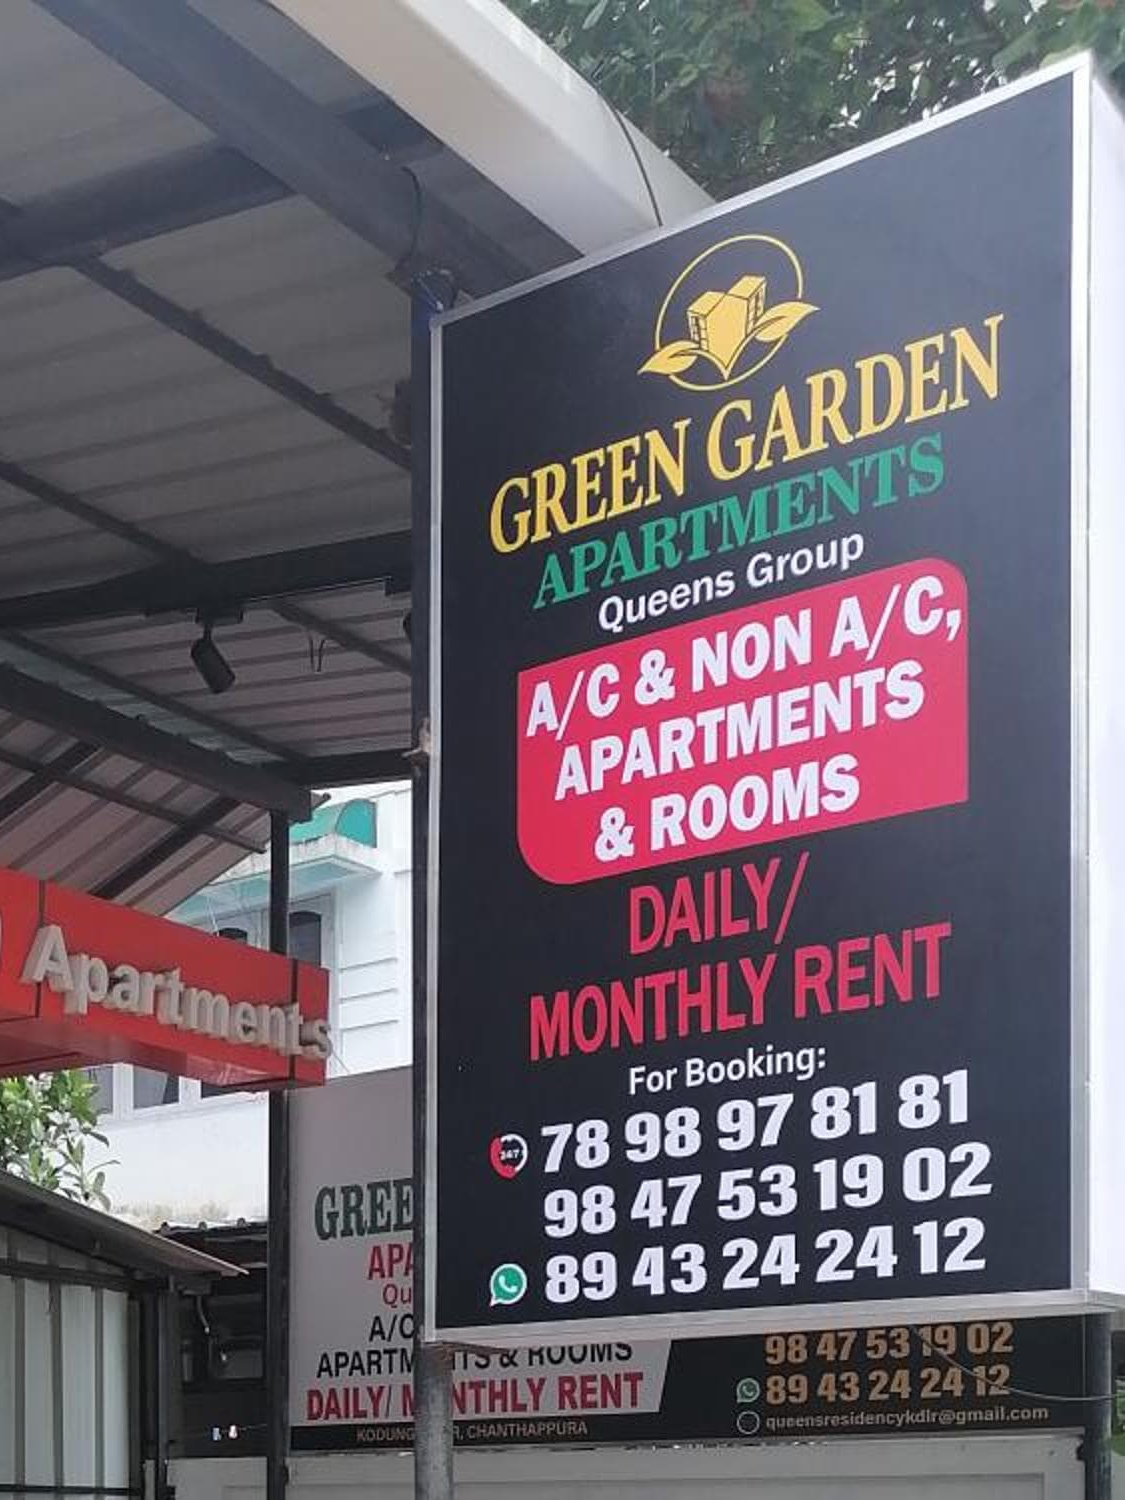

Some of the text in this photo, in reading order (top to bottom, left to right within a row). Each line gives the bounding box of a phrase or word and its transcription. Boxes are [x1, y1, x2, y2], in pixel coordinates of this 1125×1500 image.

[490, 314, 1004, 554] GREEN GARDEN
[533, 432, 947, 611] APARTMENTS
[598, 532, 865, 634] Queens Group
[526, 575, 963, 740] A/C & NON A/C,
[554, 660, 926, 801] APARTMENTS
[593, 754, 861, 865] & ROOMS
[628, 852, 811, 956] DAILY/
[20, 922, 333, 1062] Apartments
[529, 922, 953, 1062] MONTHLY RENT
[541, 1118, 610, 1174] 78
[624, 1106, 702, 1163] 98
[716, 1095, 796, 1152] 97
[811, 1081, 878, 1141] 81
[897, 1069, 971, 1128] 81
[628, 1044, 828, 1096] For Booking:
[314, 1178, 413, 1241] GREE
[543, 1141, 994, 1239] 98 47 53 19 02
[545, 1217, 987, 1304] 89 43 24 24 12
[765, 1363, 1011, 1406] 89 43 24 24 12
[766, 1321, 1014, 1365] 98 47 53 19 02
[306, 1385, 393, 1421] DAILY/
[558, 1371, 645, 1411] RENT
[468, 1420, 589, 1440] CHANTHAPPURA
